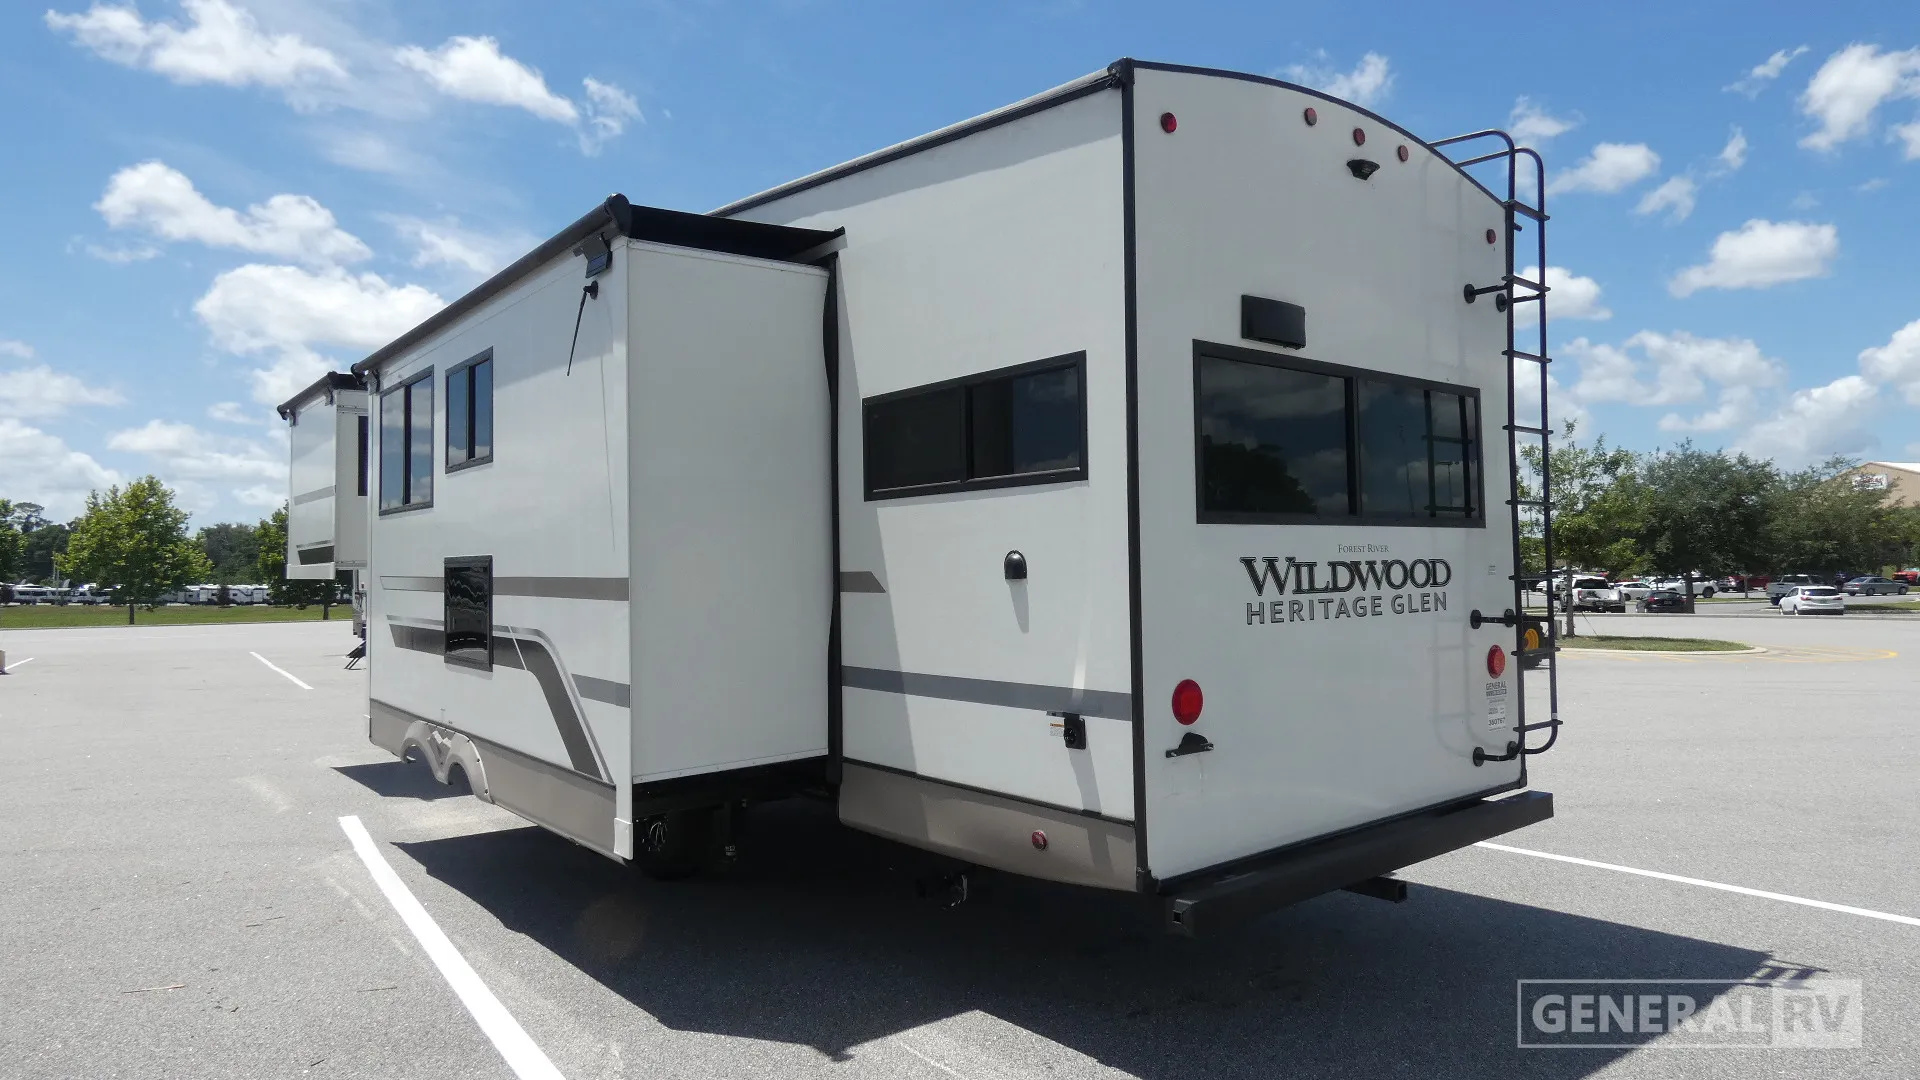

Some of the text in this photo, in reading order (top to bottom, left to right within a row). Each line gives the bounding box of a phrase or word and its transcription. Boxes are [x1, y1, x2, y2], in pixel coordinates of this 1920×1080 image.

[1338, 544, 1365, 553] FOREST
[1239, 556, 1452, 597] WILDWOOD
[1246, 592, 1448, 625] HERITAGE GLEN
[1486, 681, 1507, 691] GENERAL
